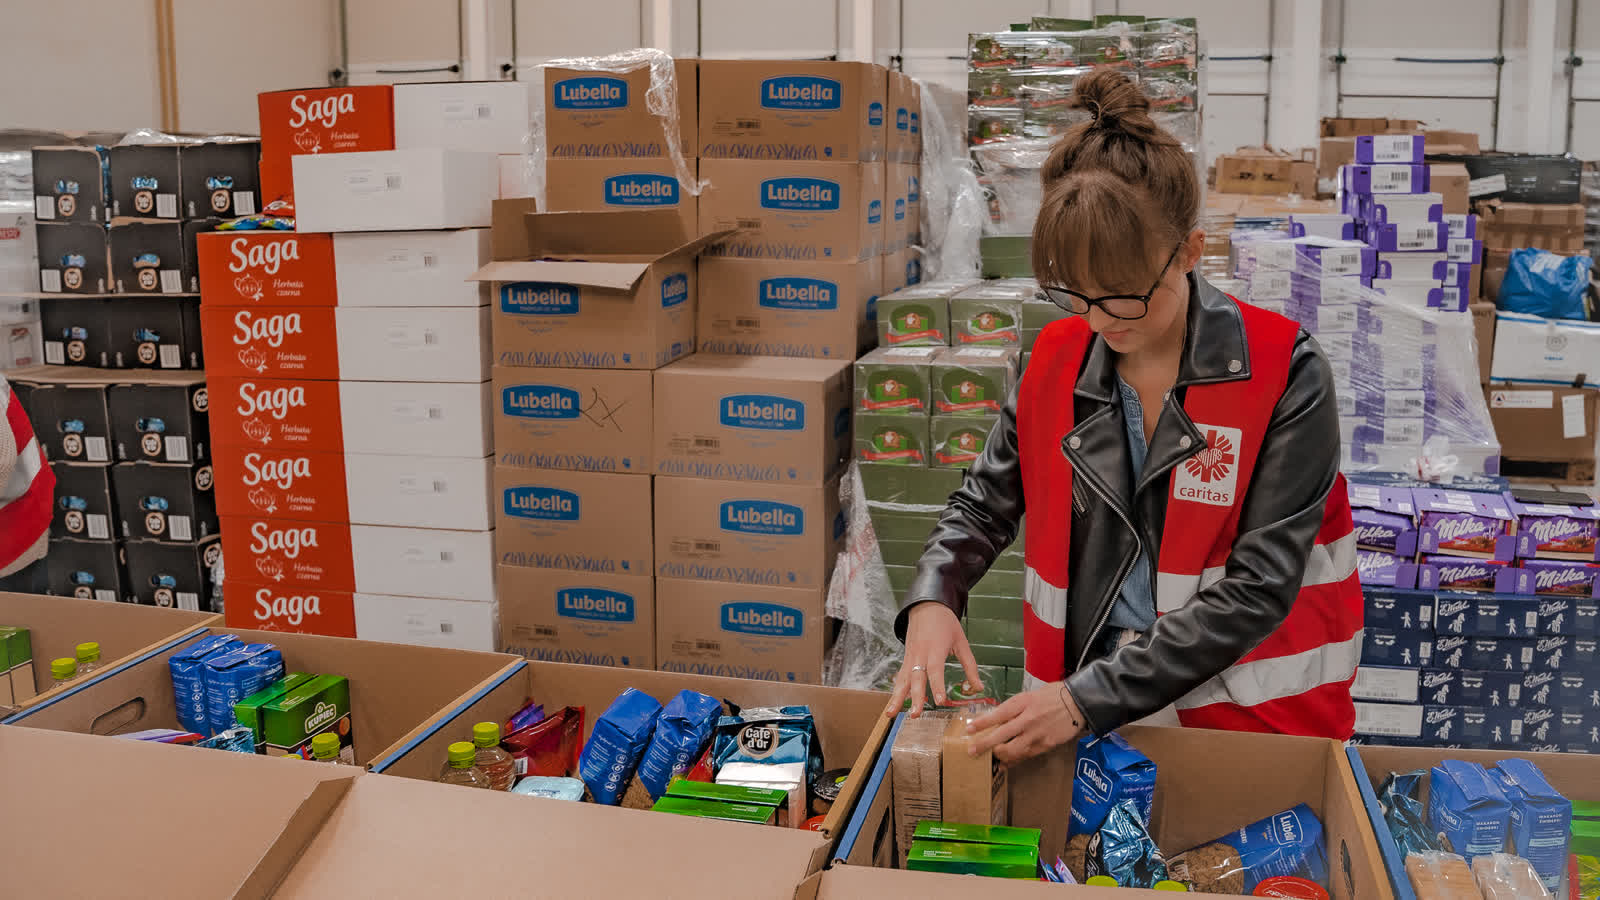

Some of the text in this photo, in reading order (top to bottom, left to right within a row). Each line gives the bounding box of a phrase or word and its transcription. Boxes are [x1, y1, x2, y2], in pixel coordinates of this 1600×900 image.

[561, 84, 621, 100] Lubella
[768, 83, 833, 101] Lubella
[289, 93, 355, 128] Saga
[612, 181, 673, 197] Lubella
[767, 184, 832, 202] Lubella
[229, 237, 300, 275] Saga
[508, 287, 571, 305] Lubella
[766, 283, 831, 302] Lubella
[233, 311, 303, 348] Saga
[237, 382, 306, 420] Saga
[509, 391, 572, 410] Lubella
[727, 400, 797, 421] Lubella
[243, 452, 311, 490] Saga
[510, 491, 572, 513] Lubella
[1179, 486, 1229, 502] caritas
[727, 505, 796, 527] Lubella
[1434, 516, 1486, 540] Milka
[1529, 517, 1581, 542] Milka
[250, 521, 318, 559] Saga
[1439, 565, 1487, 582] Milka
[1536, 568, 1587, 588] Milka
[254, 588, 321, 625] Saga
[564, 592, 627, 614] Lubella
[728, 607, 795, 629] Lubella
[308, 708, 335, 729] KUPIEC
[1083, 762, 1108, 793] Lubella
